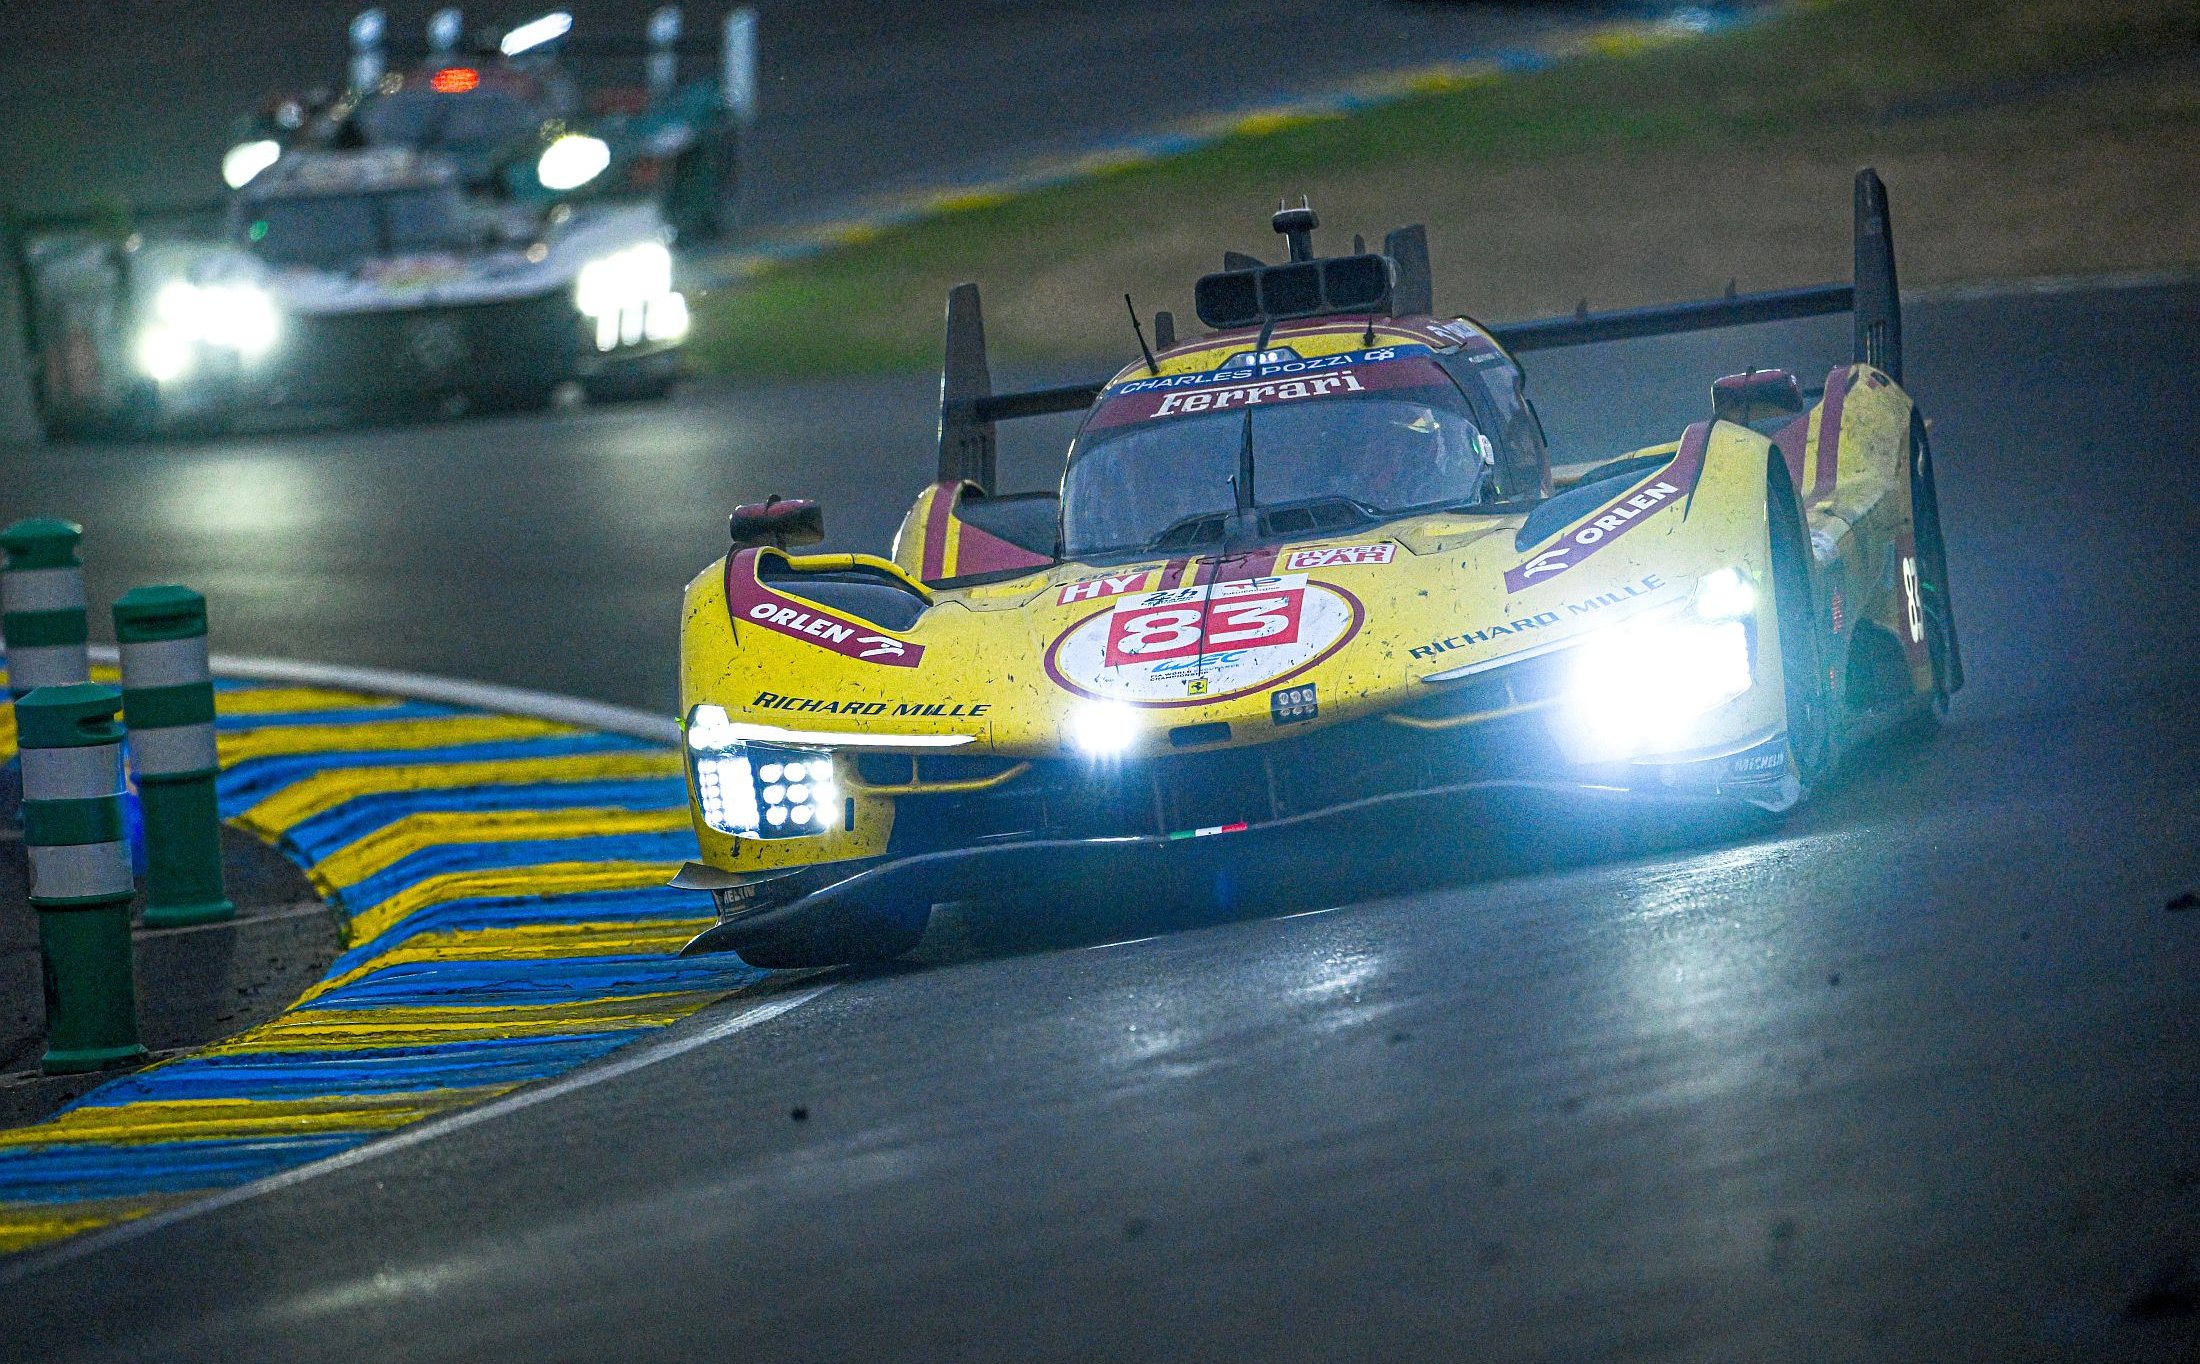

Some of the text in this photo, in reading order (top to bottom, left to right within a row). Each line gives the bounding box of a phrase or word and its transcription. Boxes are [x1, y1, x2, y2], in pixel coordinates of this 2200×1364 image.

[1120, 354, 1353, 395] CHARLES POZZI
[1150, 371, 1365, 418] Ferrari
[1575, 480, 1680, 545] ORLEN
[1294, 551, 1386, 568] CAR
[1297, 545, 1388, 559] HYPER
[1061, 573, 1143, 604] HY
[749, 602, 855, 645] ORLEN
[1117, 597, 1290, 655] 83
[1407, 574, 1667, 660] RICHARD MILLE
[752, 691, 992, 717] RICHARD MILLE
